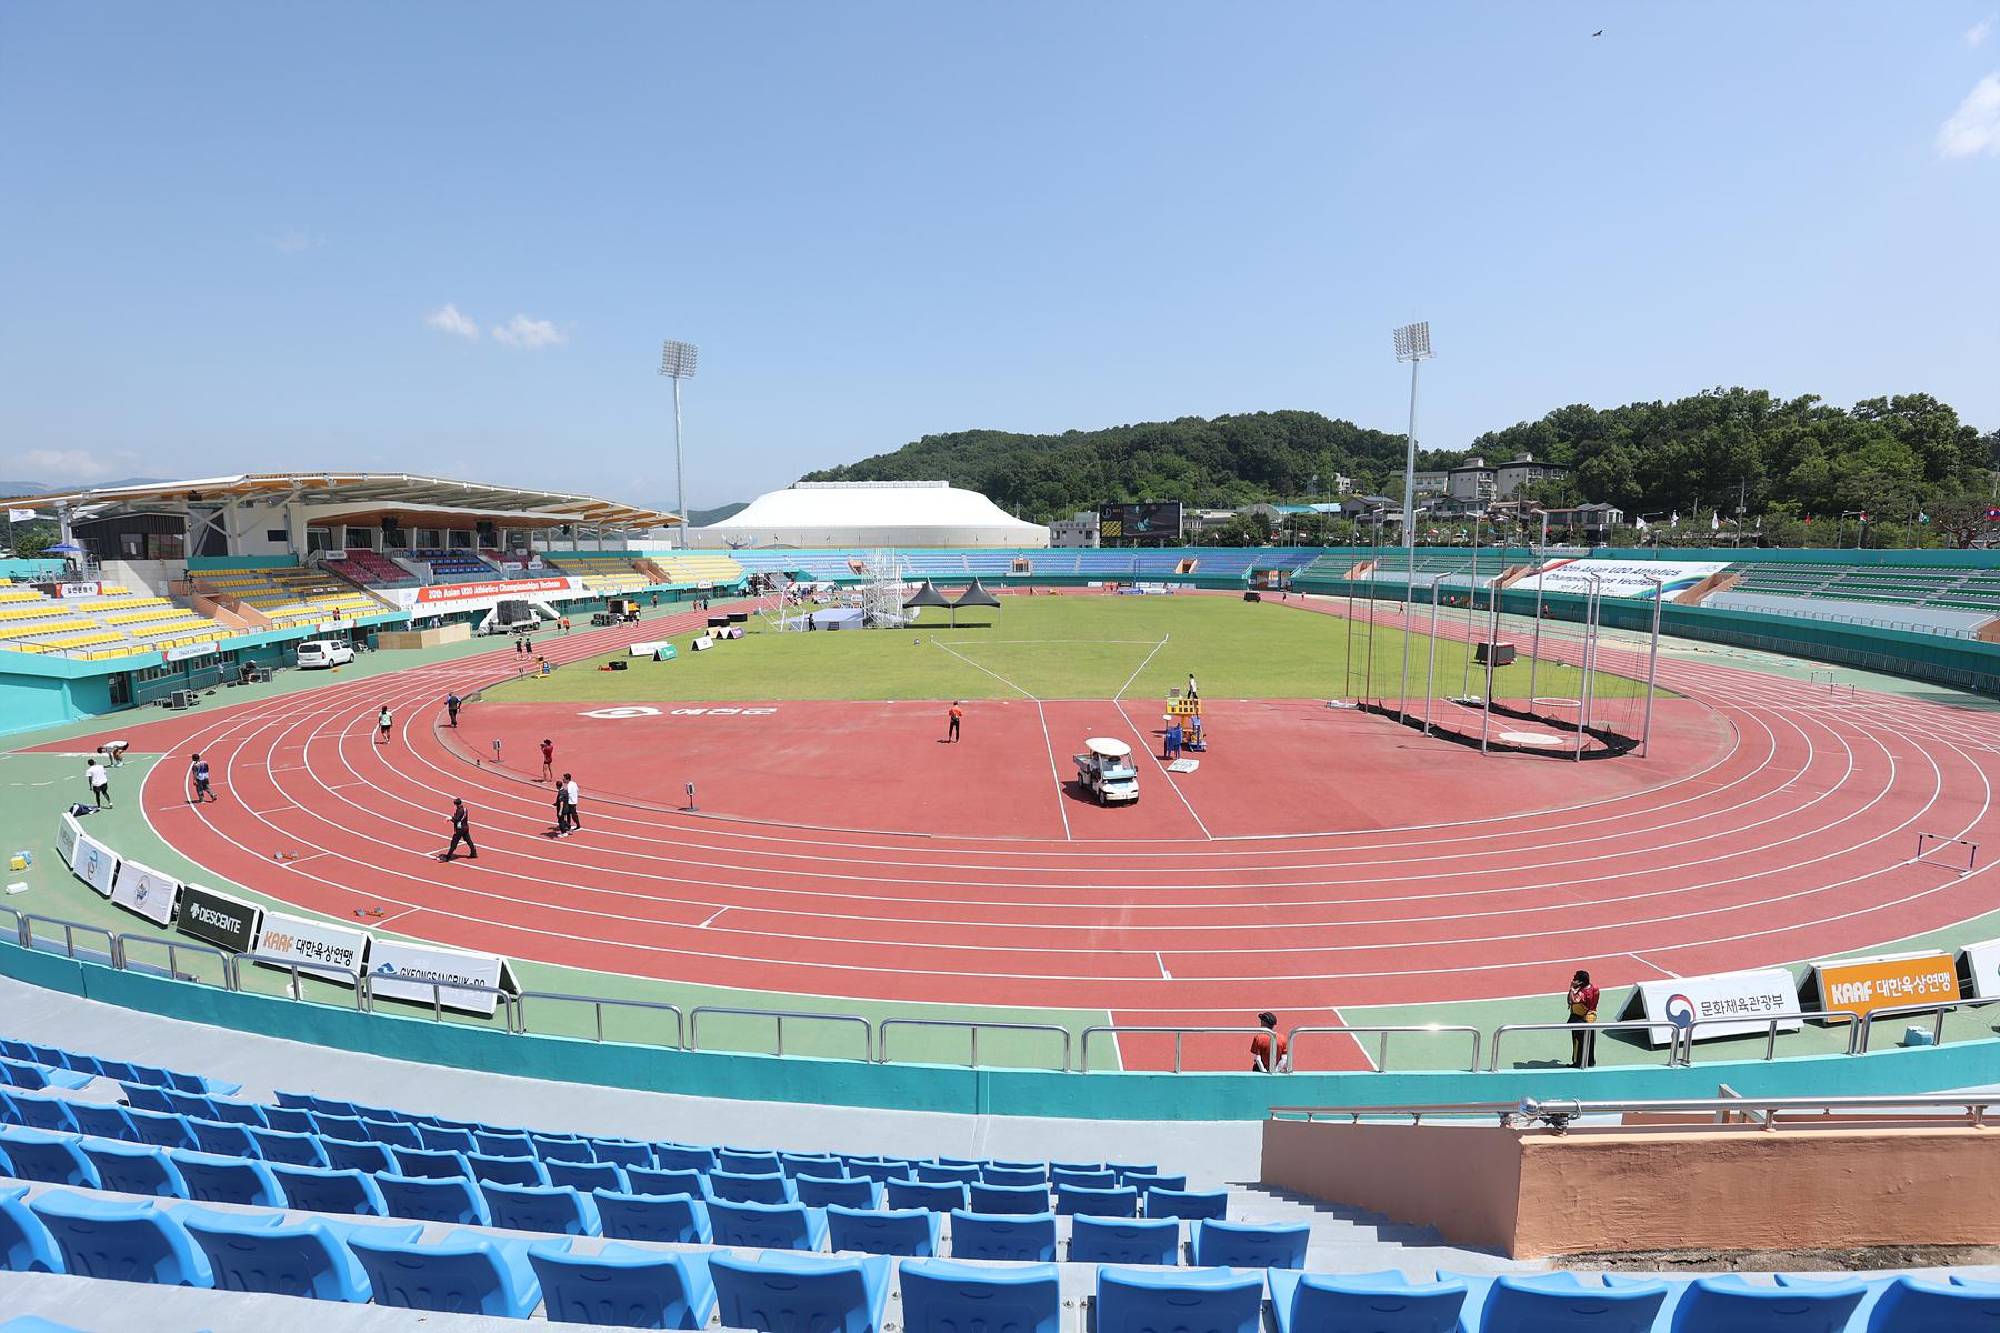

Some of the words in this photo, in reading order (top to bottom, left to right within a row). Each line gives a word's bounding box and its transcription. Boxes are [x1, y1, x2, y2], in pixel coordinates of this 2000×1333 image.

[1632, 567, 1682, 576] Athletics
[428, 589, 443, 599] 20th
[444, 588, 461, 597] Asian
[461, 587, 473, 595] U20
[474, 584, 499, 594] Athletics
[499, 581, 540, 593] Championships
[199, 908, 242, 934] DESCENTE
[263, 930, 295, 953] KAAF
[296, 938, 354, 967] 대한육상연맹
[1831, 980, 1873, 1005] KAAF
[1875, 972, 1951, 997] 대한육상연맹
[1701, 993, 1784, 1017] 문화체육관광부
